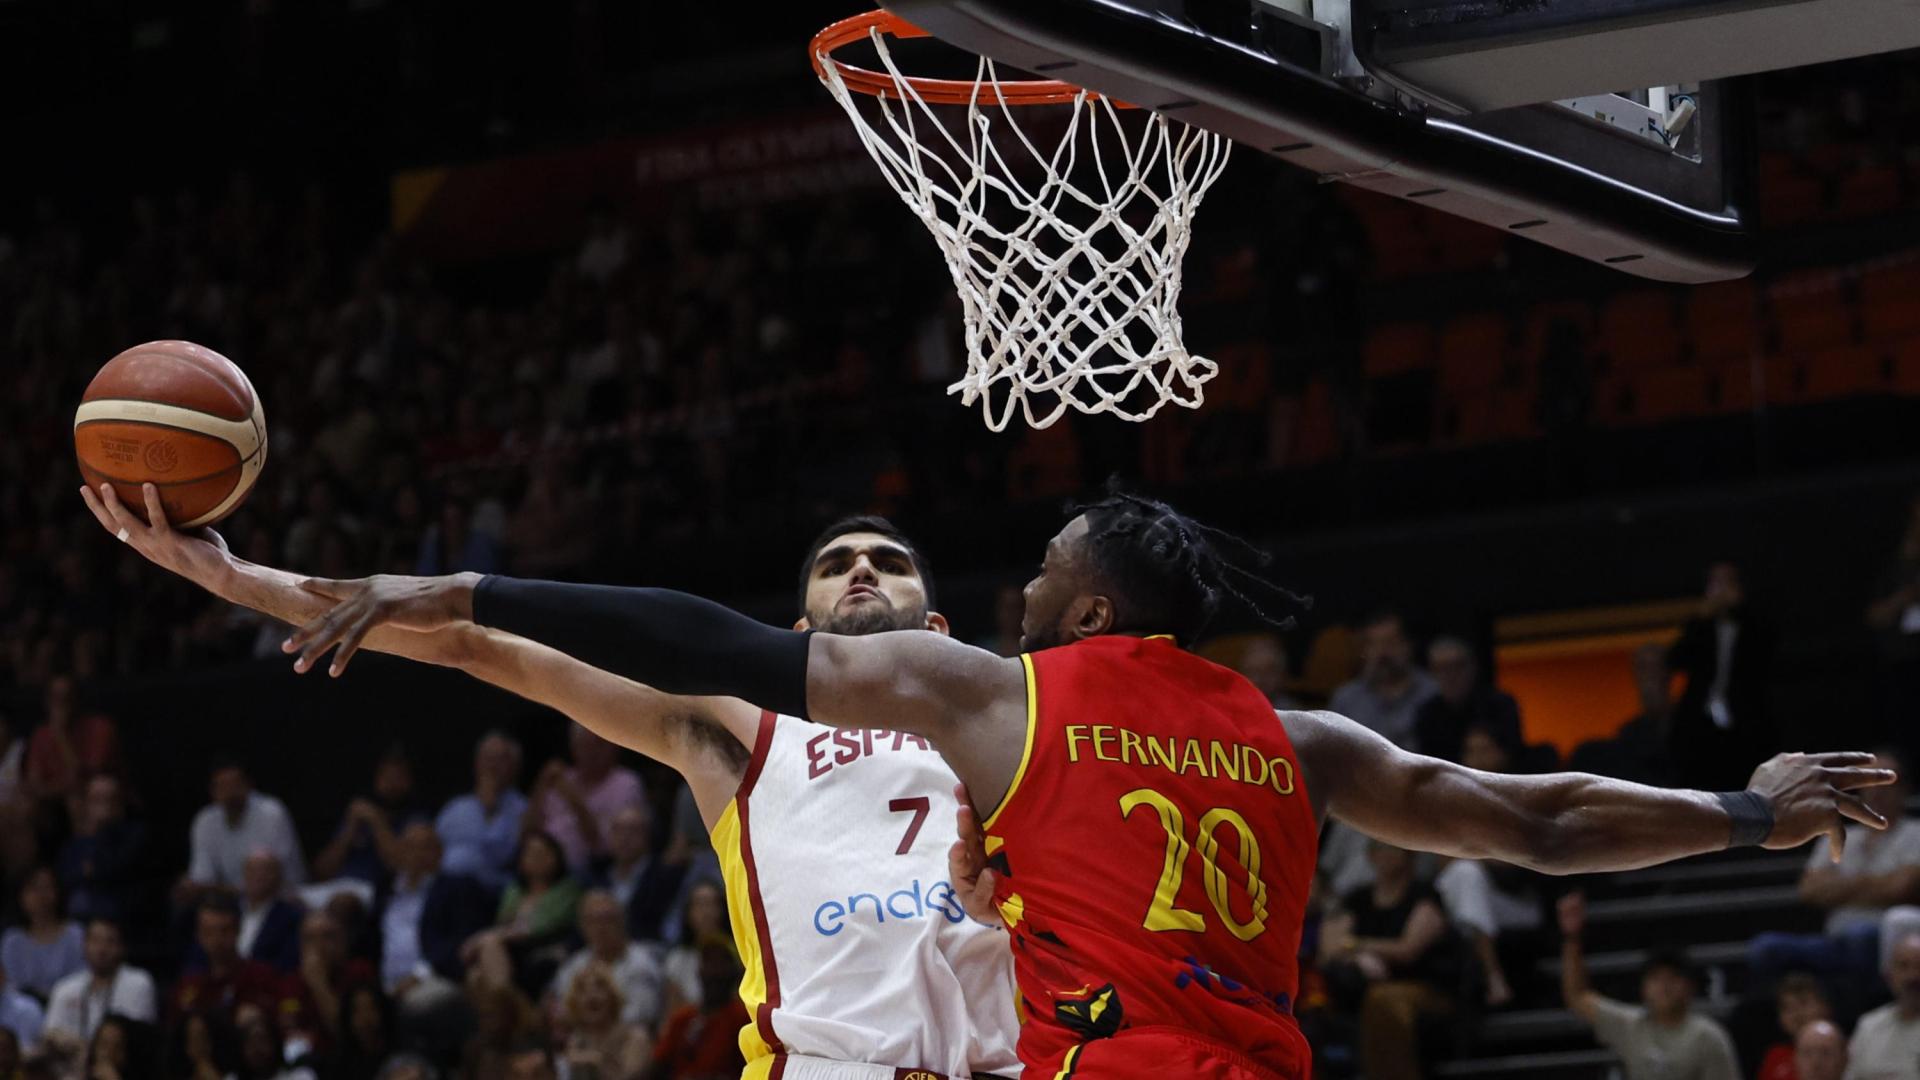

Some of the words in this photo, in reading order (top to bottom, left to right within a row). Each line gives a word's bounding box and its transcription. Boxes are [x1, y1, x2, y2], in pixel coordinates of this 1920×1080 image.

[806, 728, 938, 780] ESPA
[1065, 724, 1295, 795] FERNANDO
[889, 796, 931, 856] 7
[1118, 788, 1269, 942] 20
